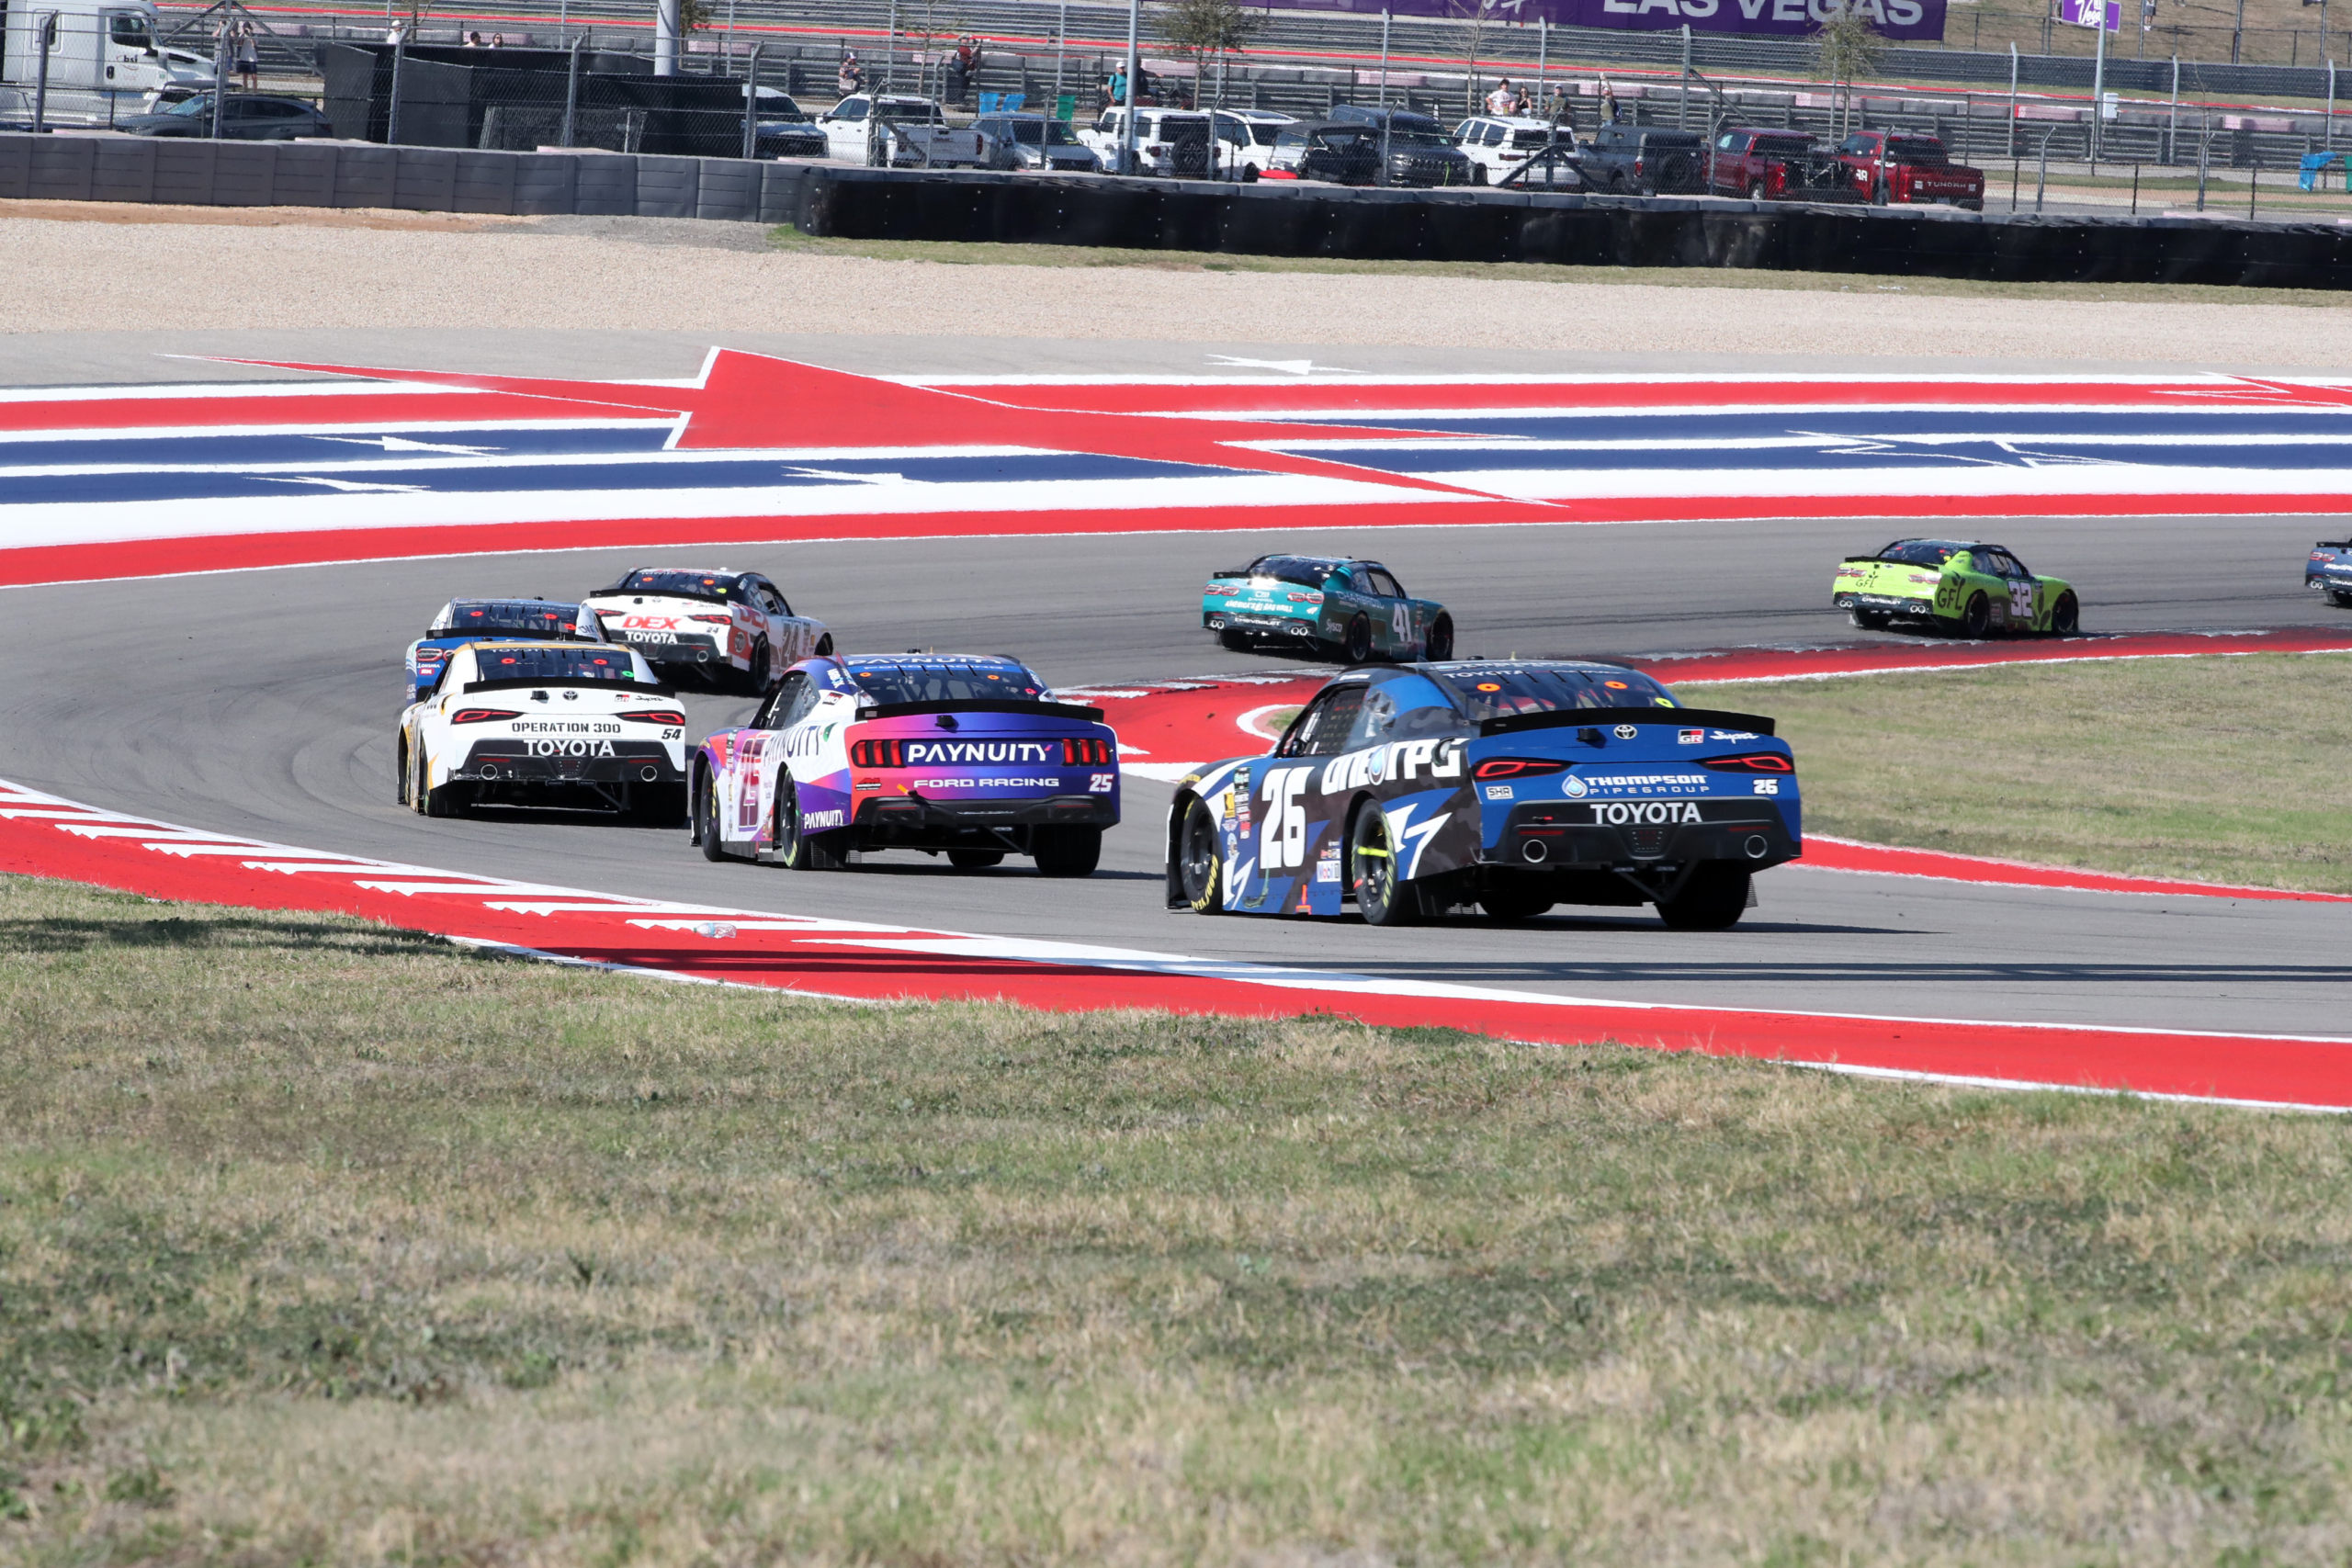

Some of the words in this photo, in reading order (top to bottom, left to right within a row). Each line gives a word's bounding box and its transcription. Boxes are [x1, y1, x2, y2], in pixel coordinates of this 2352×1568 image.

[1856, 576, 1874, 588] GFL
[1861, 596, 1902, 605] CHEVROLET
[1937, 580, 1964, 611] GFL
[2007, 580, 2033, 618] 32
[622, 615, 683, 630] DEX
[1234, 617, 1282, 626] CHEVROLET
[1392, 603, 1412, 642] 41
[626, 631, 678, 645] TOYOTA
[1442, 670, 1530, 679] TOYOTA
[512, 722, 589, 733] OPERATION
[594, 723, 621, 734] 300
[661, 728, 682, 740] 54
[1679, 734, 1702, 743] GR
[1710, 730, 1759, 744] Supra
[524, 739, 616, 757] TOYOTA
[908, 743, 1053, 762] PAYNUITY
[913, 778, 975, 788] FORD
[978, 777, 1060, 787] RACING
[1089, 773, 1114, 793] 25
[1584, 774, 1707, 786] THOMPSON
[1753, 778, 1781, 795] 26
[1487, 787, 1511, 797] SHR
[1589, 785, 1711, 795] PIPEGROUP
[804, 809, 845, 829] PAYNUITY
[1260, 766, 1315, 870] 26
[1590, 802, 1702, 825] TOYOTA
